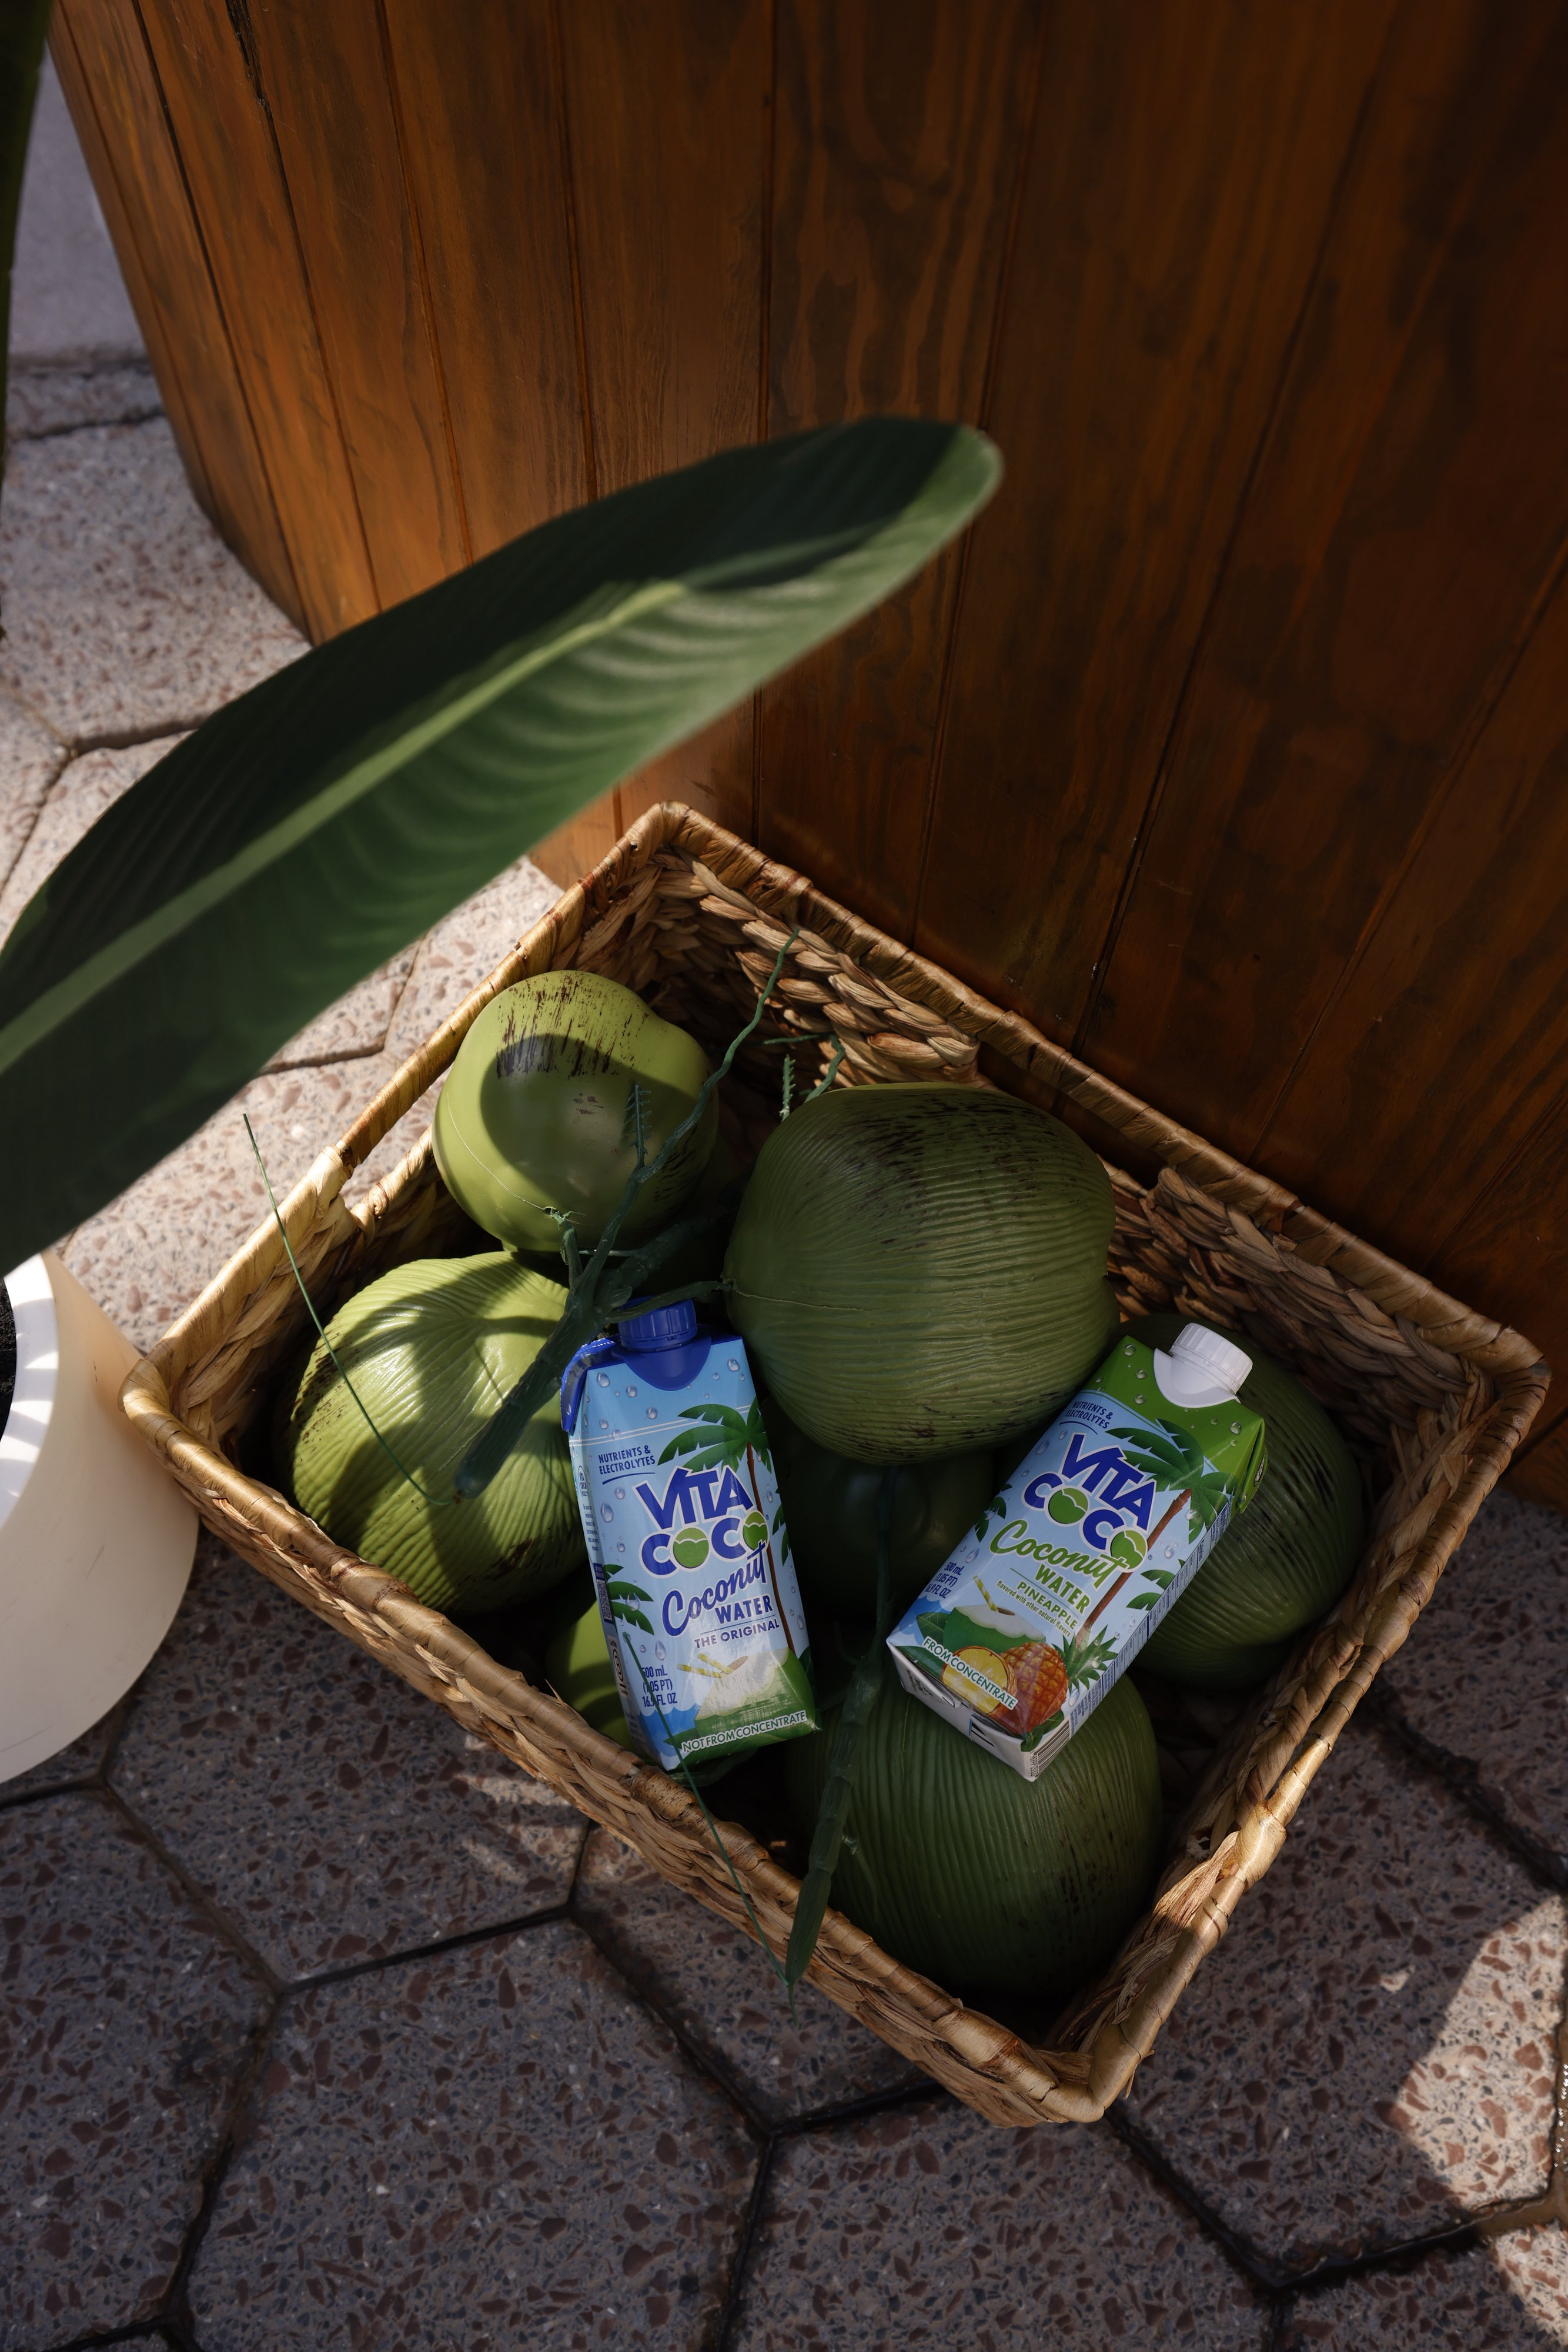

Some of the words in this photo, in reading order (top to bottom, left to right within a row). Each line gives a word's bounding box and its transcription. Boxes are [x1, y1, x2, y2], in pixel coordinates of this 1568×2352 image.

[1065, 1409, 1110, 1429] ELECTROLYTES
[1071, 1401, 1106, 1415] NUTRIENTS
[1106, 1412, 1113, 1421] &
[598, 1447, 642, 1464] NUTRIENTS
[644, 1445, 651, 1454] &
[599, 1455, 656, 1475] ELECTROLYTES
[1061, 1433, 1155, 1532] VITA
[634, 1466, 754, 1530] VITA
[1023, 1472, 1147, 1571] COCO
[640, 1511, 769, 1576] COCO
[989, 1519, 1131, 1589] Coconut
[944, 1562, 957, 1572] 500
[952, 1566, 965, 1575] mL
[944, 1575, 958, 1588] PT)
[662, 1541, 767, 1636] Coconut
[931, 1585, 942, 1595] FL
[939, 1588, 951, 1599] OZ
[1035, 1563, 1090, 1615] WATER
[715, 1595, 773, 1624] WATER
[997, 1581, 1018, 1596] flavored
[1015, 1593, 1027, 1604] with
[1025, 1602, 1038, 1613] other
[1038, 1611, 1056, 1625] natural
[1055, 1621, 1071, 1638] flavors
[1017, 1581, 1078, 1630] PINEAPPLE
[694, 1635, 717, 1648] THE
[720, 1619, 780, 1642] ORIGINAL
[655, 1665, 668, 1677] mL
[923, 1638, 951, 1662] FROM
[950, 1656, 1017, 1708] CONCENTRATE
[643, 1680, 659, 1694] (05
[660, 1679, 673, 1690] PT)
[656, 1694, 666, 1706] FL
[667, 1692, 677, 1704] OZ
[683, 1738, 705, 1752] NOT
[706, 1730, 735, 1746] FROM
[736, 1711, 806, 1738] CONCENTRATE
